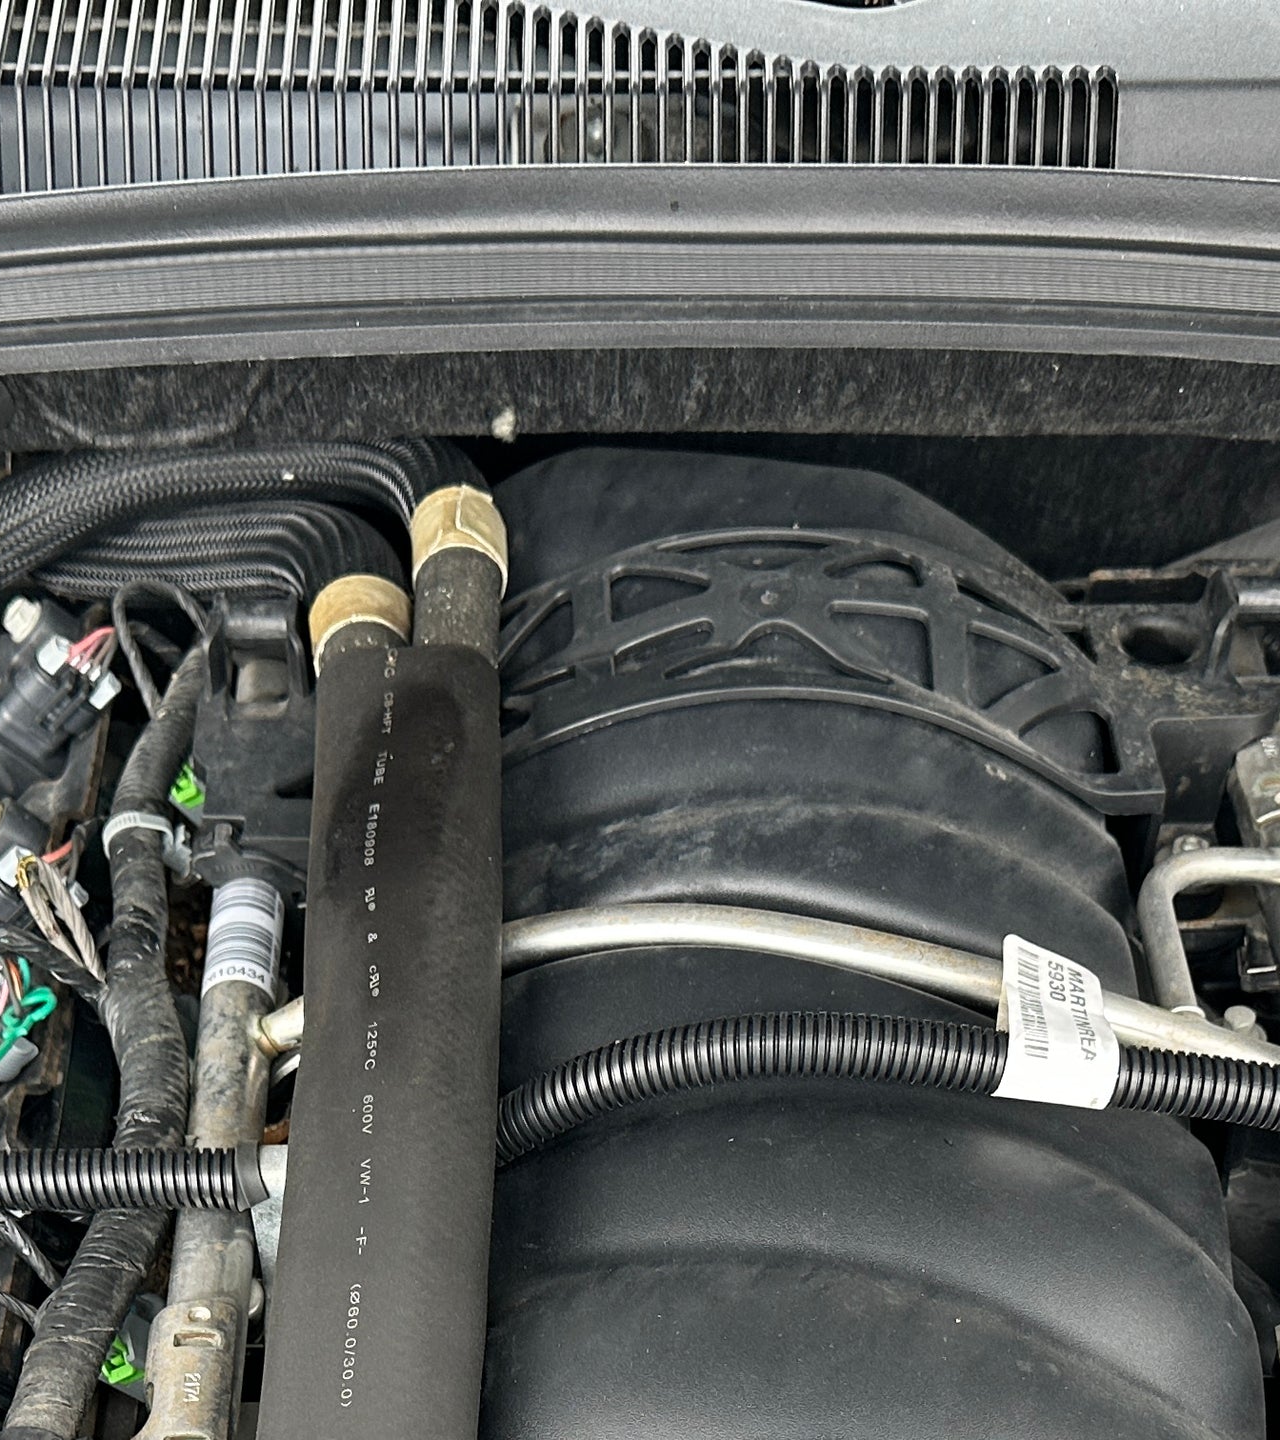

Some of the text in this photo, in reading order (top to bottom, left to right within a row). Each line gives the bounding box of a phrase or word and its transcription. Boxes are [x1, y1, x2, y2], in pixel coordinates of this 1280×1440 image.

[373, 751, 388, 786] TUBE
[364, 803, 380, 867] E180908
[1047, 960, 1067, 1002] 5930
[1066, 965, 1097, 1062] MARTINREA
[361, 1093, 374, 1135] 600V
[357, 1158, 372, 1205] VW-1
